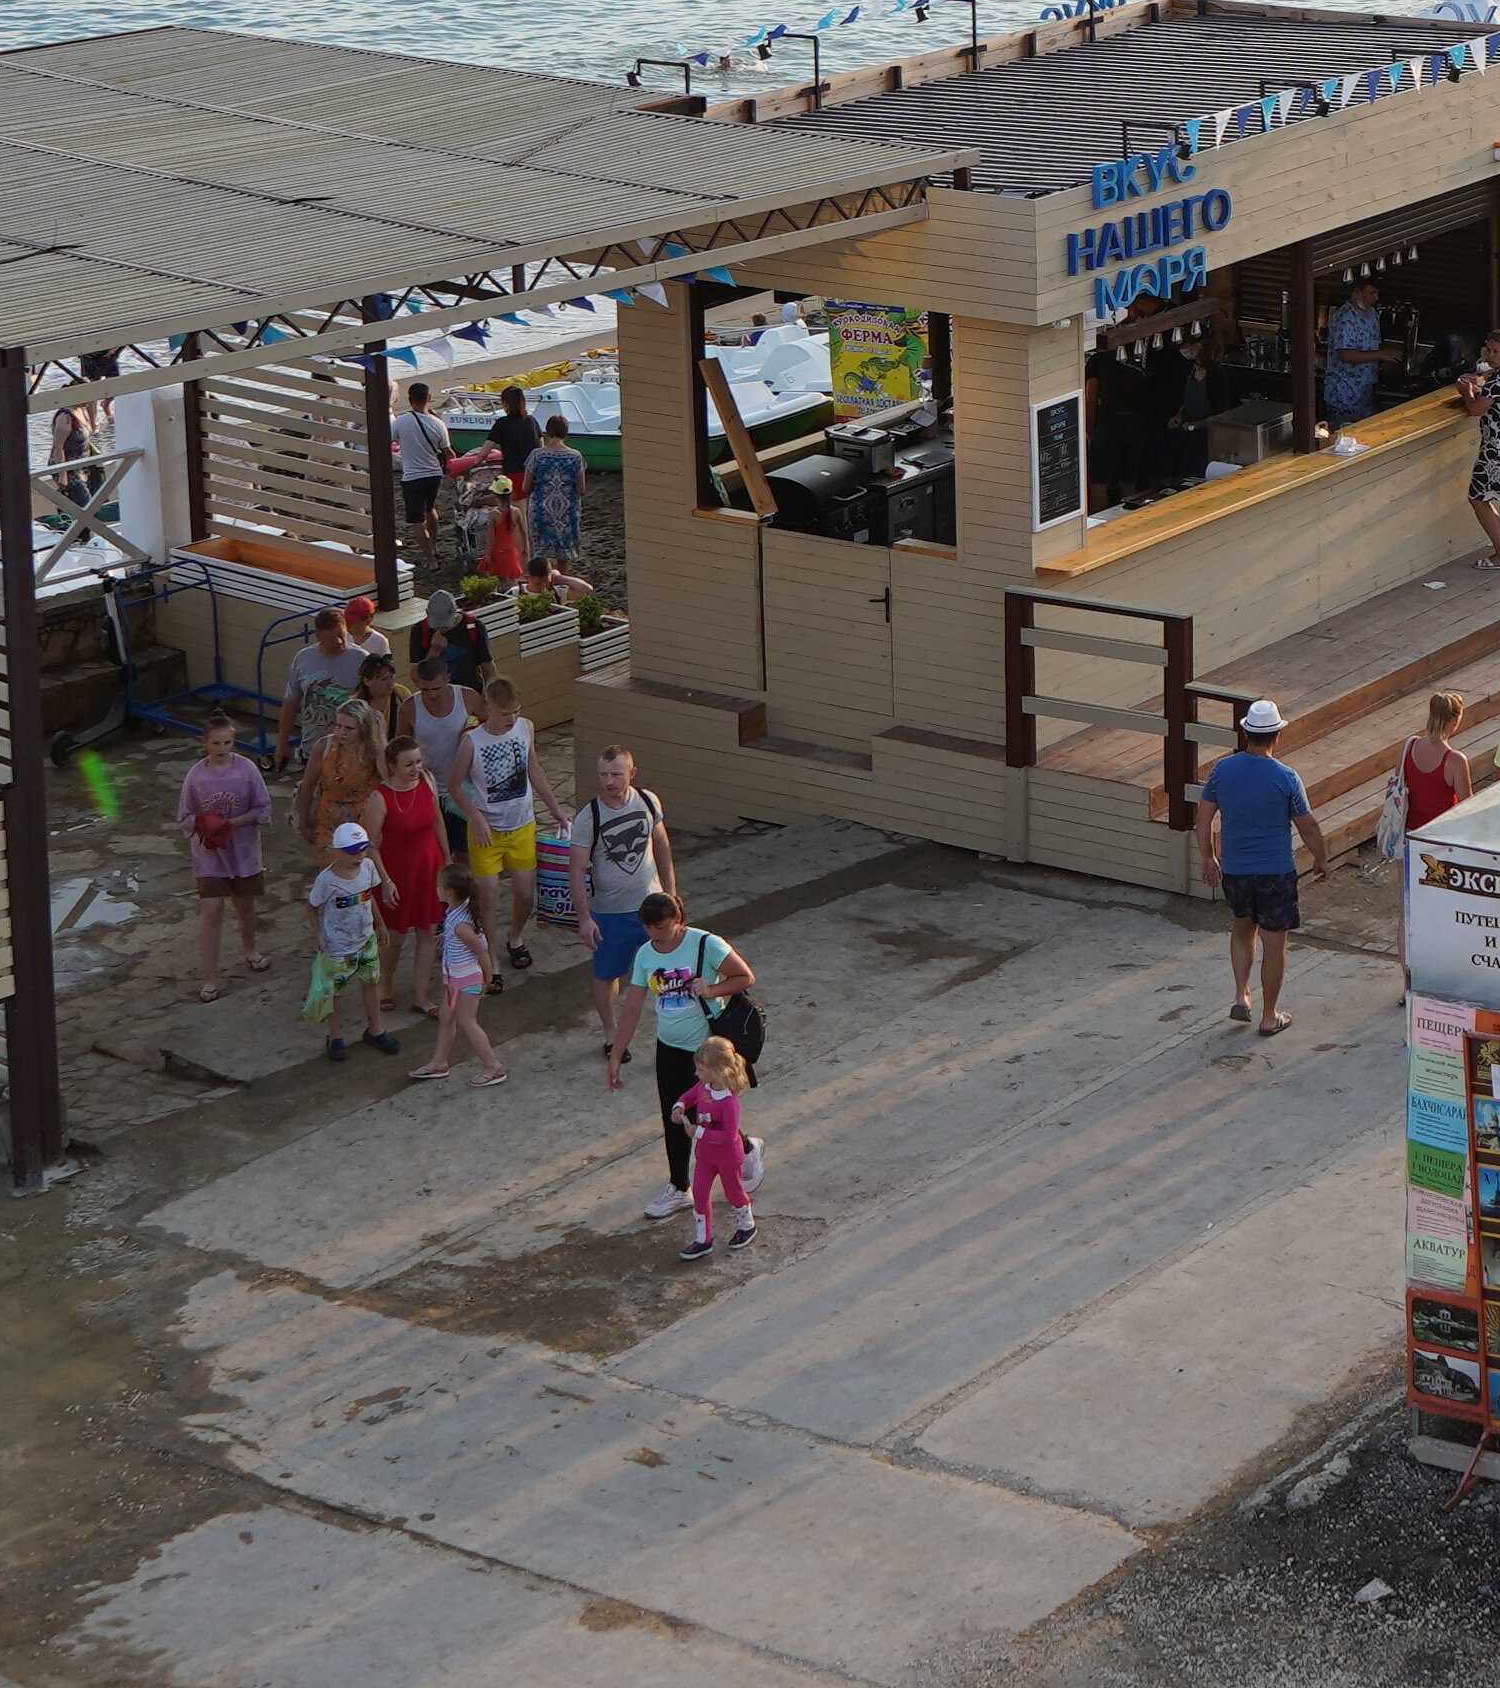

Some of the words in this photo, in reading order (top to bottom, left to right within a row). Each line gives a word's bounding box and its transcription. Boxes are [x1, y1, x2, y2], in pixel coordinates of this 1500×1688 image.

[1092, 145, 1198, 209] ВКУС
[1067, 188, 1233, 276] НАШЕГО
[1094, 245, 1208, 320] МОРЯ
[832, 312, 902, 335] КРОКОДИЛОВАЯ
[840, 327, 895, 346] ФЕРМА
[836, 393, 874, 407] БЕСПЛАТНАЯ
[1485, 936, 1498, 949] И
[1422, 1154, 1463, 1173] ПЕЩЕРА
[1413, 1238, 1466, 1259] АКВАТУР
